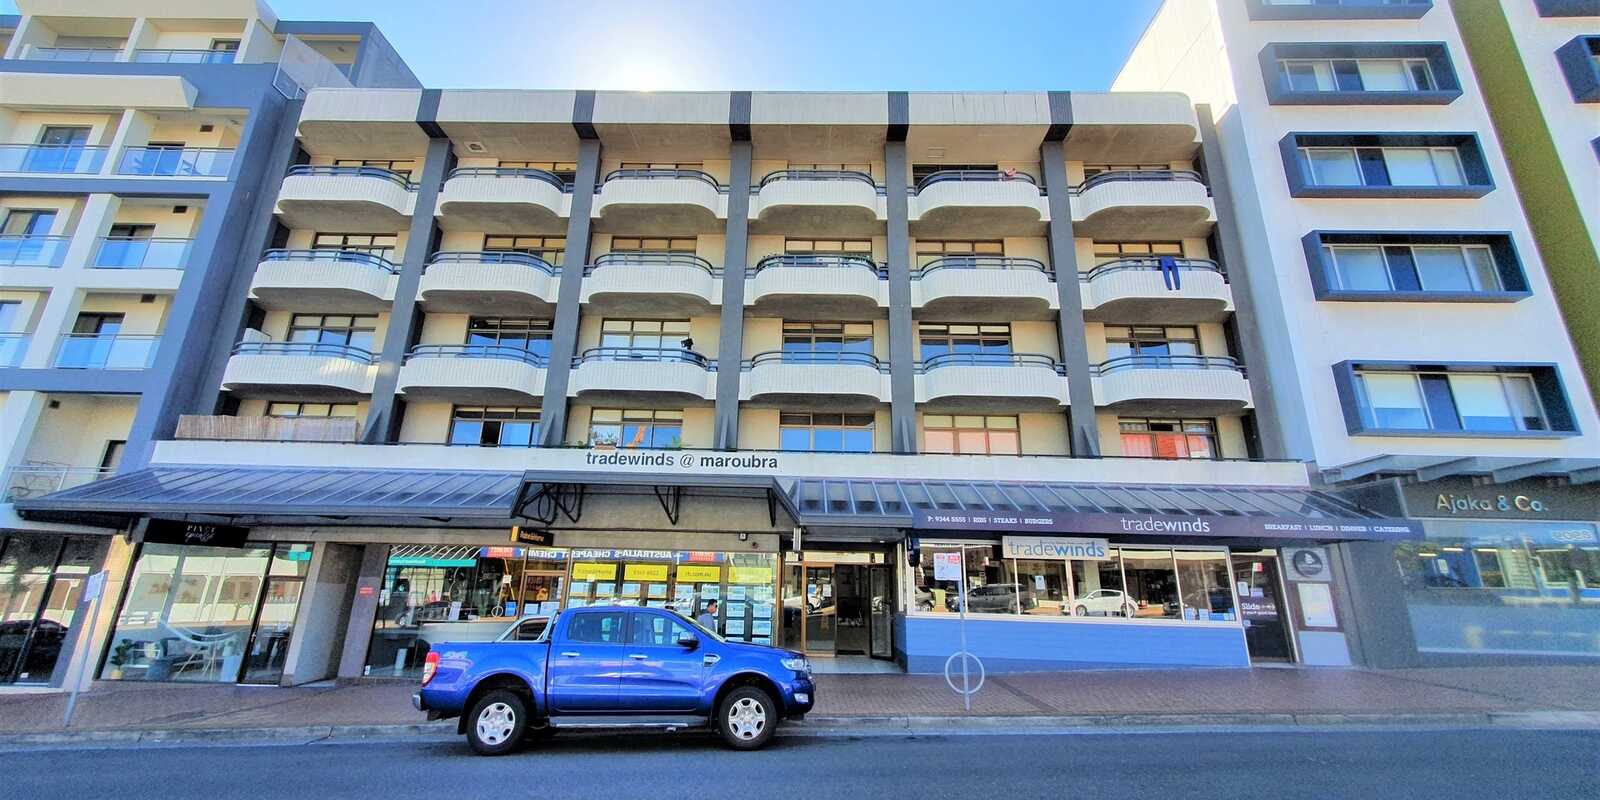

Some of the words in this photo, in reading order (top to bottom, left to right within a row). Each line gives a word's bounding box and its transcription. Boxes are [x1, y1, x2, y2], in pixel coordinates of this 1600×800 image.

[586, 451, 674, 467] tradewinds
[680, 453, 694, 468] @
[700, 454, 778, 468] maroubra
[1437, 493, 1493, 514] Ajaka
[1497, 495, 1509, 511] &
[1121, 517, 1210, 533] tradewinds
[1008, 538, 1105, 558] tradewinds
